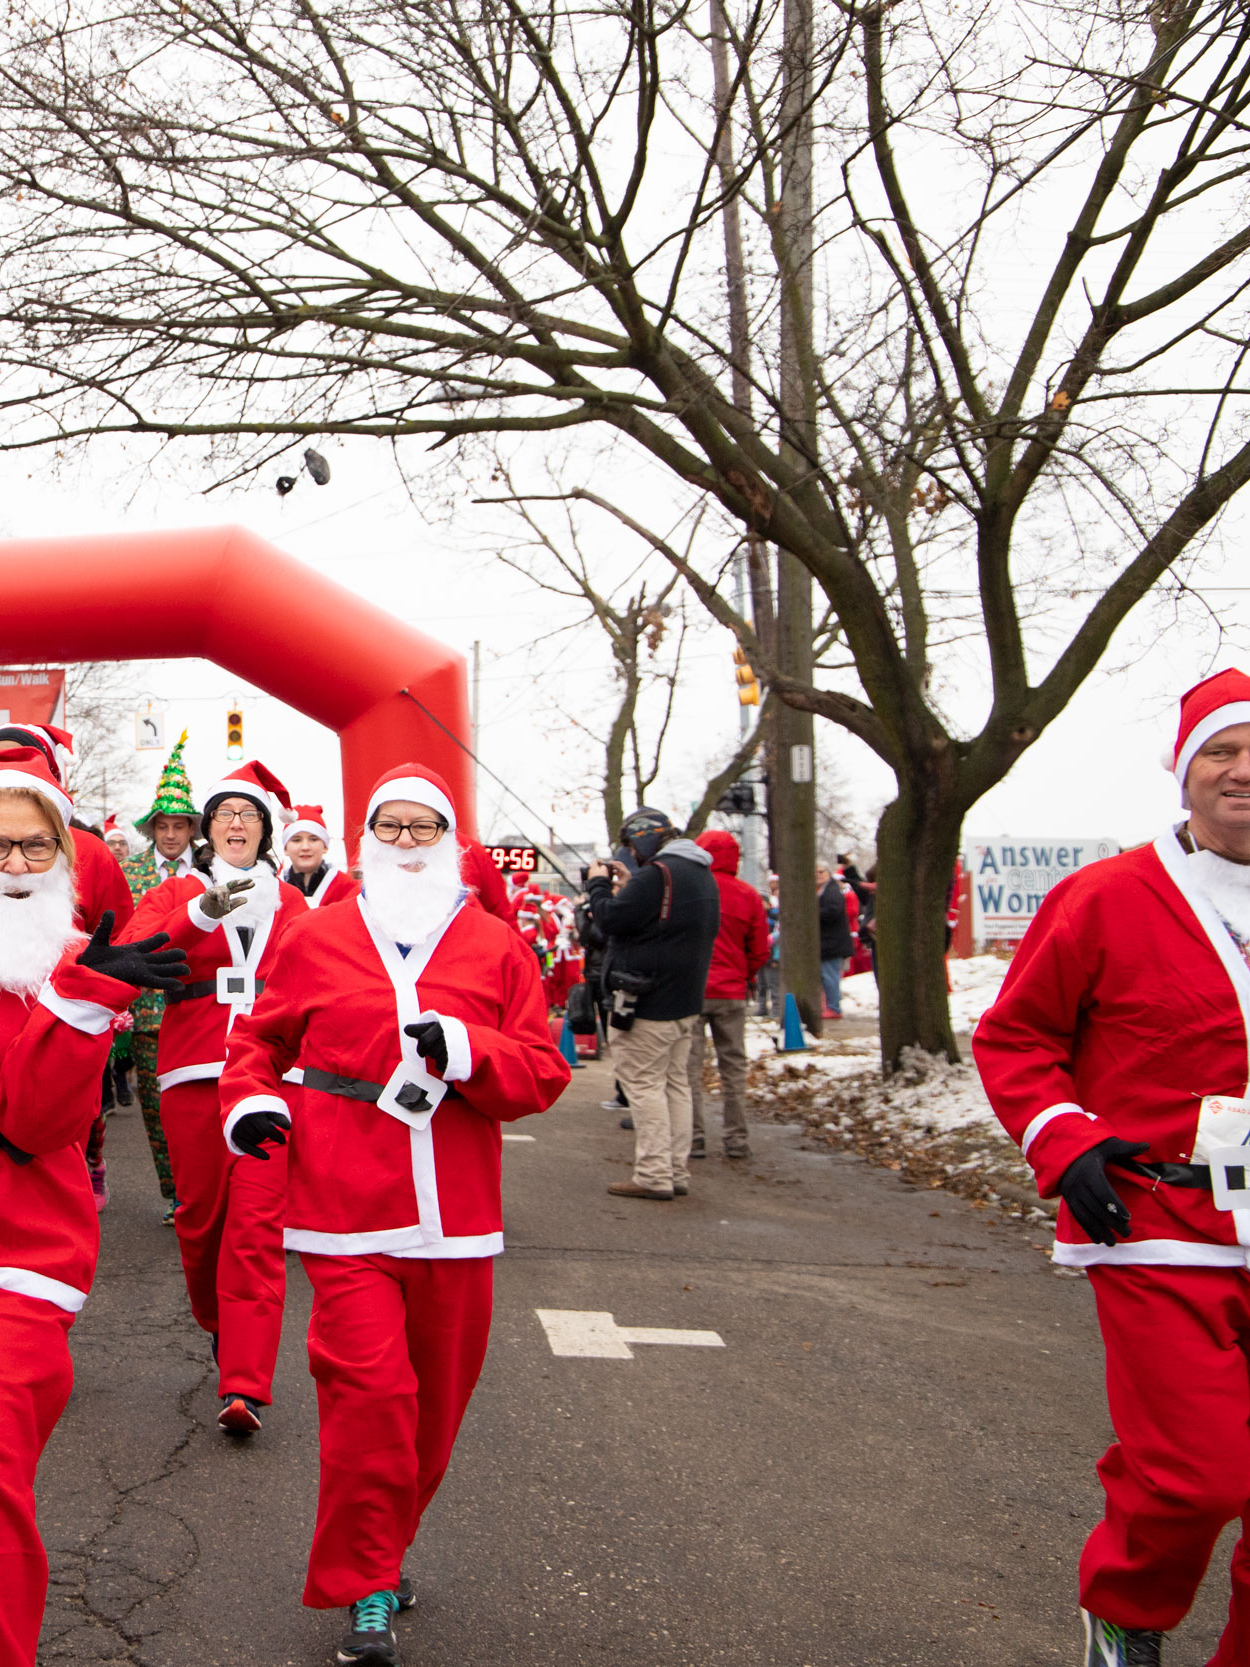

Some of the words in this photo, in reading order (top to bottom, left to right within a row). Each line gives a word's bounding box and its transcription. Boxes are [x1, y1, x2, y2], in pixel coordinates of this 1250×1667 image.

[979, 845, 1084, 875] Answer
[1006, 867, 1077, 891] cent
[977, 884, 1046, 914] Wom
